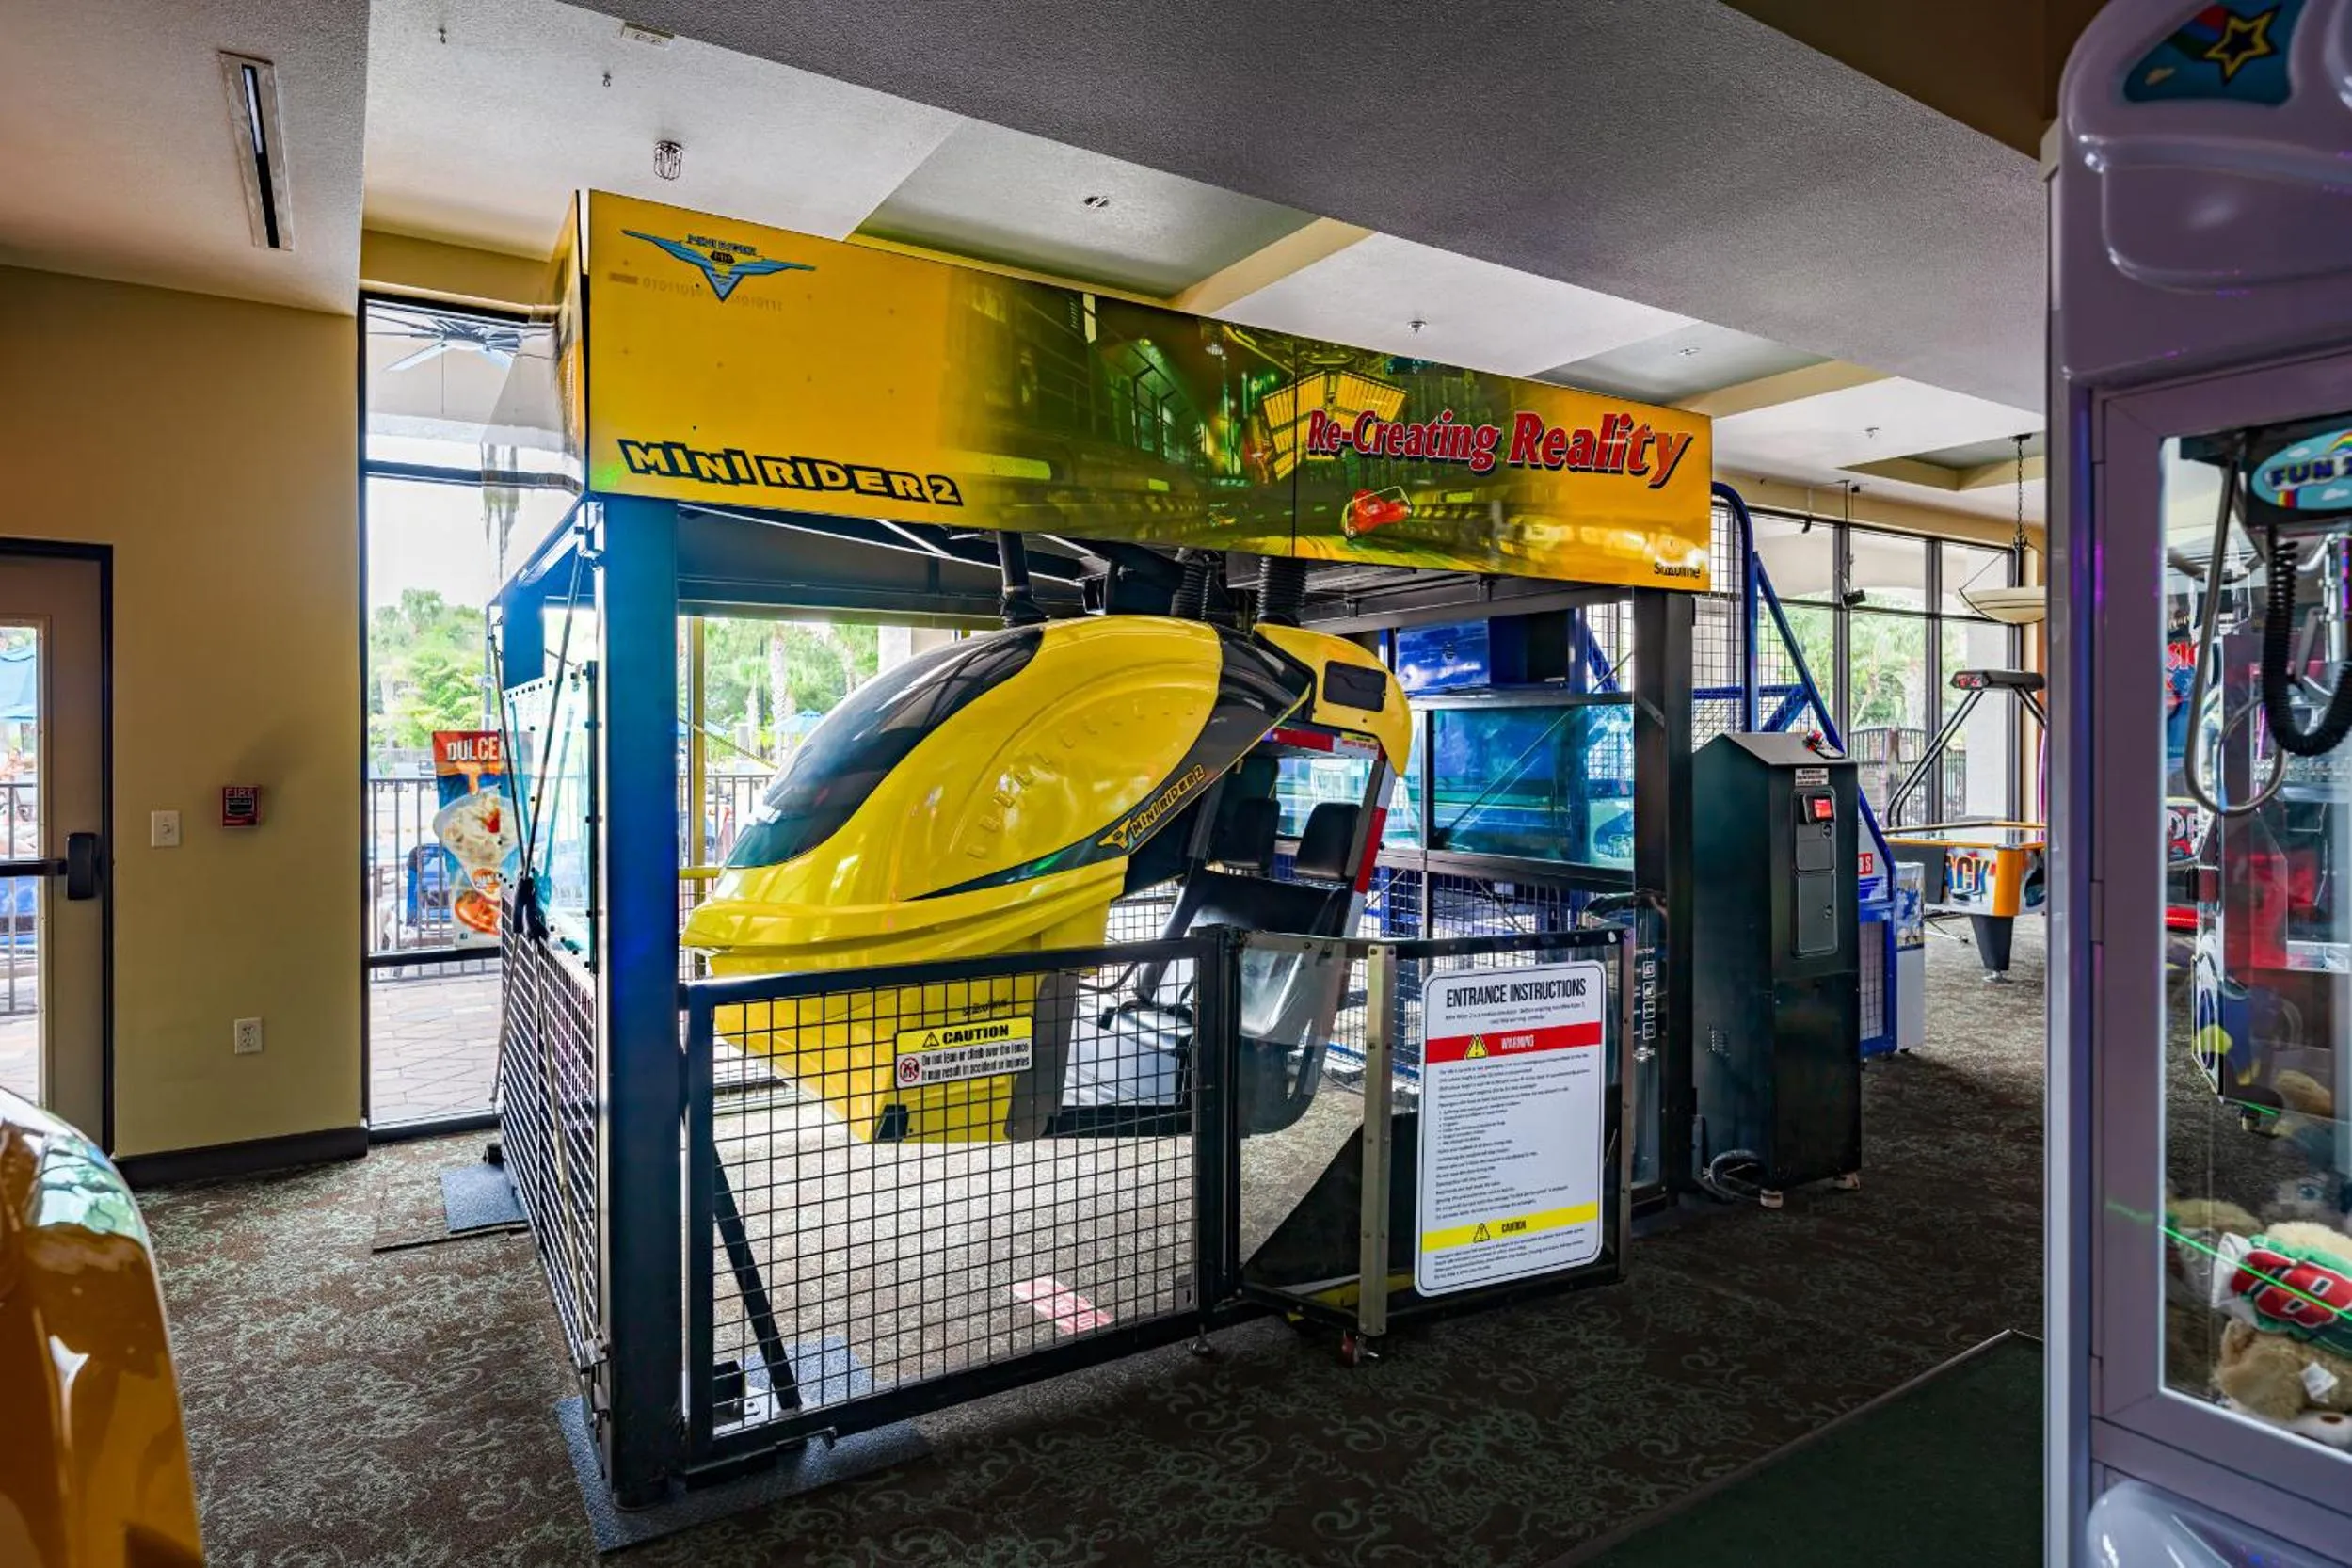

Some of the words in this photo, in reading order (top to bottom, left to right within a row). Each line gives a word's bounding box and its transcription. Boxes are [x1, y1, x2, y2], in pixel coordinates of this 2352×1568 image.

[1306, 408, 1503, 477] Re-Creating
[1506, 410, 1694, 488] Reality
[2266, 458, 2335, 488] FUN
[1446, 984, 1507, 1008] ENTRANCE
[1509, 978, 1588, 1002] INSTRUCTIONS
[943, 1025, 1009, 1044] CAUTION
